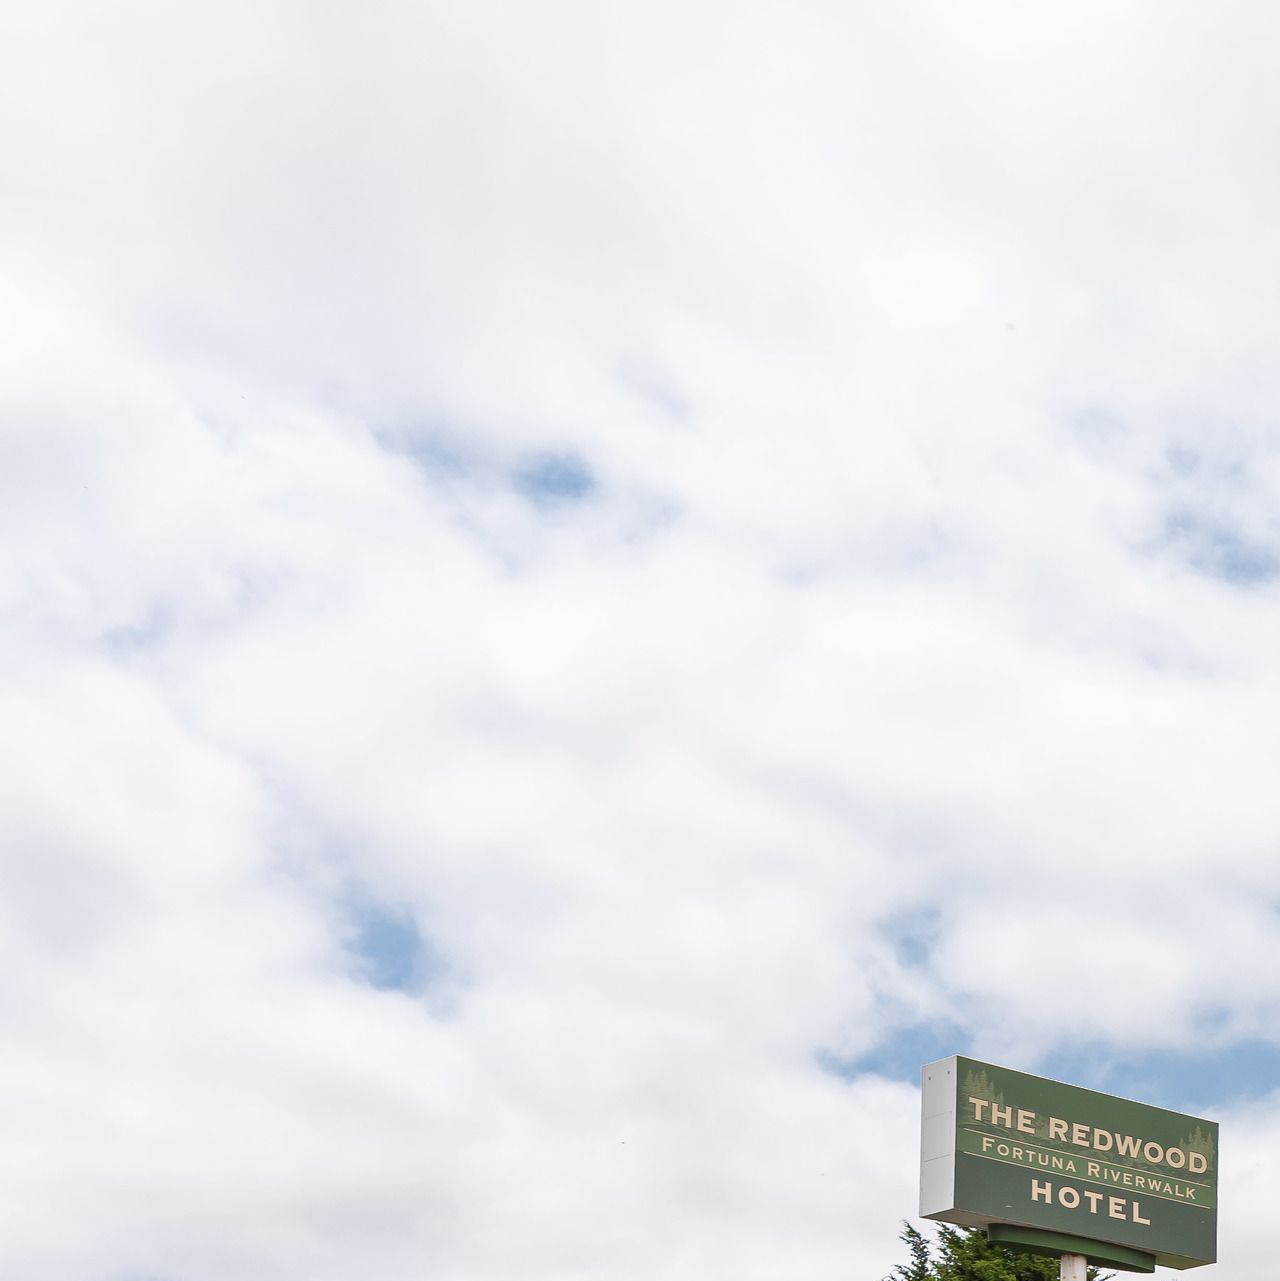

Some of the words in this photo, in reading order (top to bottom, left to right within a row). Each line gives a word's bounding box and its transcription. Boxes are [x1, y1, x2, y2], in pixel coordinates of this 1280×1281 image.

[968, 1096, 1036, 1135] THE
[1048, 1116, 1208, 1174] REDWOOD
[982, 1136, 1077, 1172] FORTUNA
[1087, 1161, 1196, 1200] RIVERWALK
[1031, 1179, 1151, 1226] HOTEL
